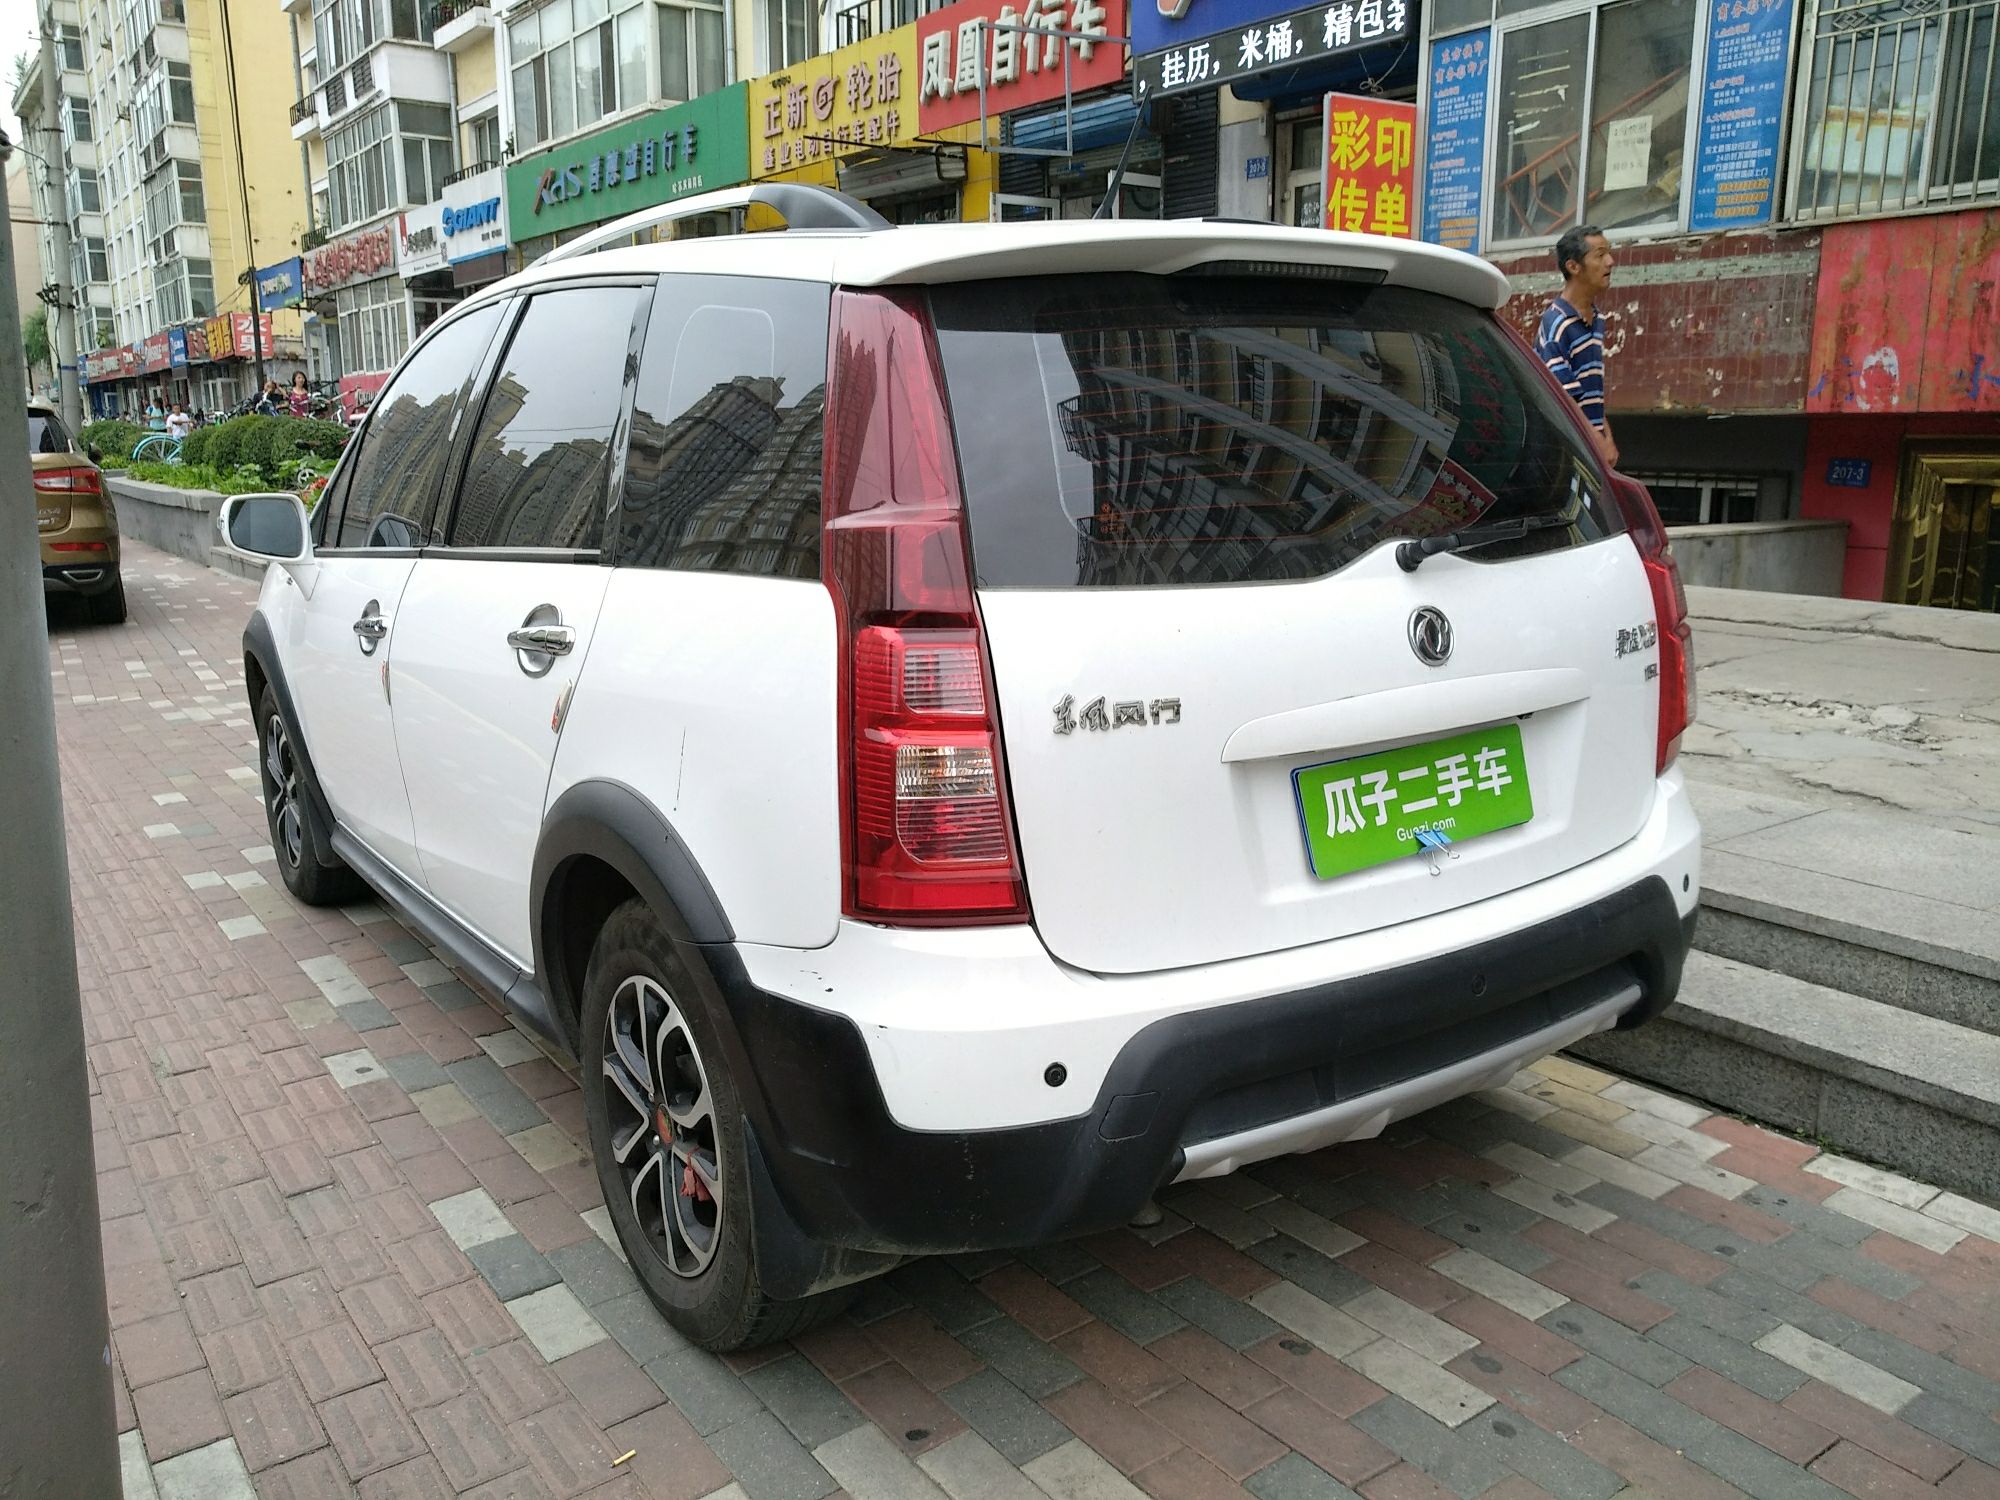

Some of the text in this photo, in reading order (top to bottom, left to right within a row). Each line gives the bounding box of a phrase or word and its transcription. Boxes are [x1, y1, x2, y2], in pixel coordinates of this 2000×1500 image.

[920, 0, 1108, 105] 凤凰自行车
[764, 52, 902, 138] 正新 轮胎
[1331, 111, 1411, 176] 彩印
[453, 197, 501, 232] GIANT
[1328, 178, 1409, 236] 传单
[1832, 466, 1864, 481] 207-3
[1322, 746, 1513, 839] 瓜子二手车
[1396, 815, 1456, 842] Guazi.com
